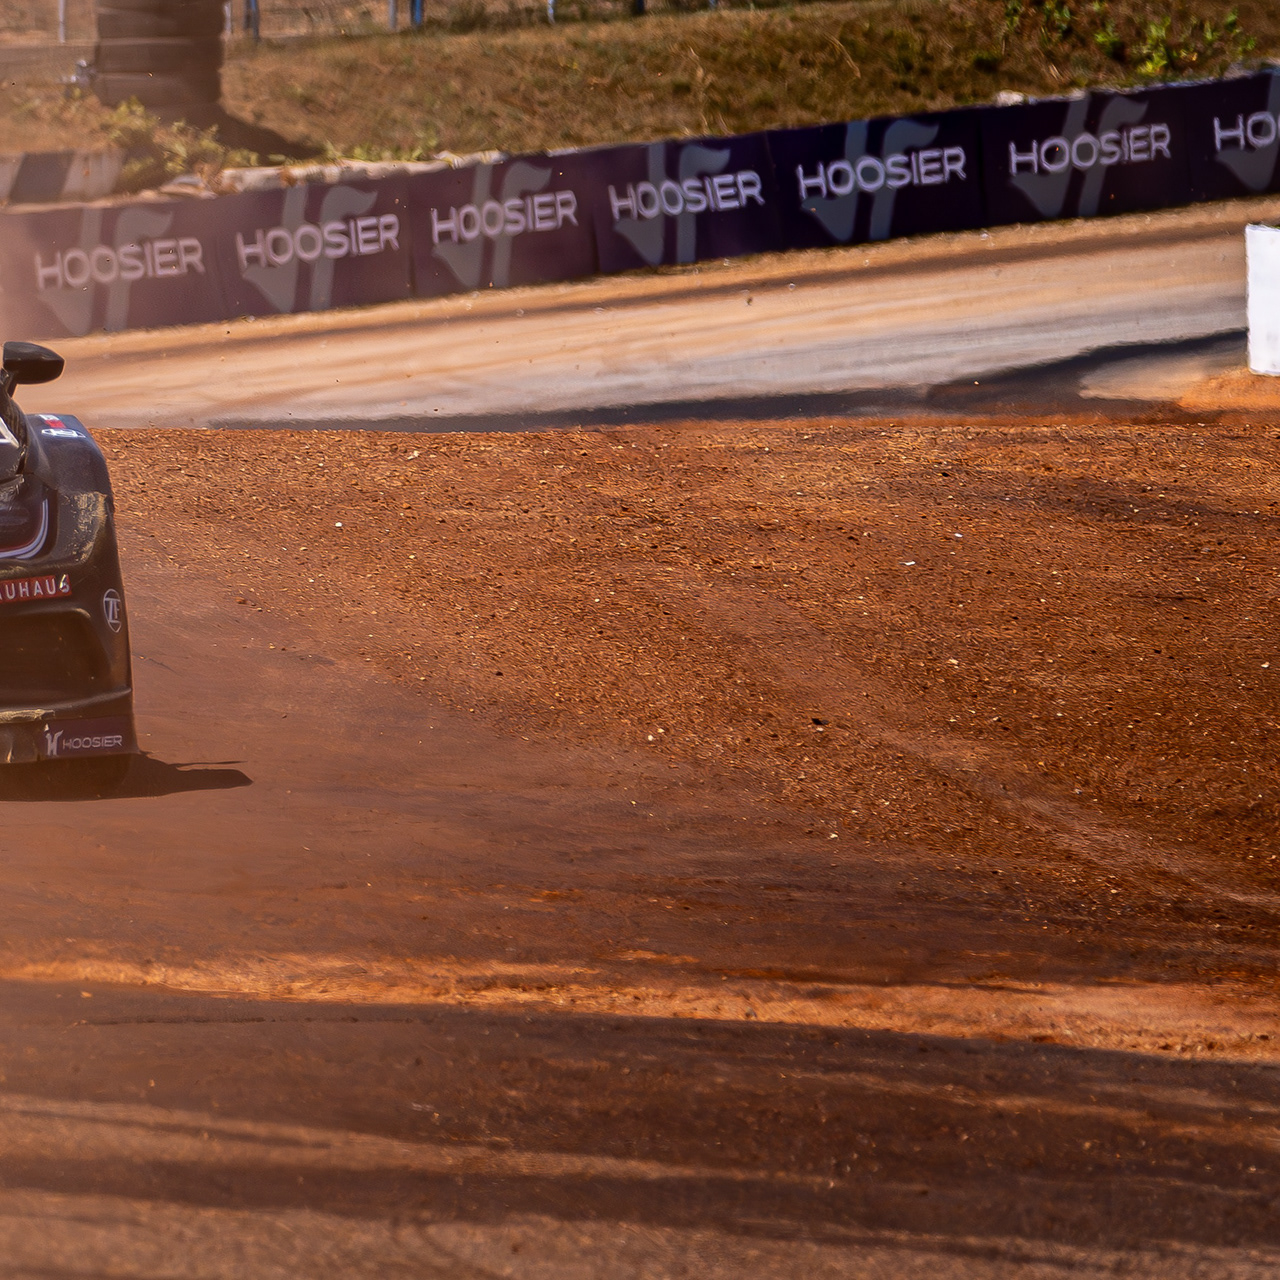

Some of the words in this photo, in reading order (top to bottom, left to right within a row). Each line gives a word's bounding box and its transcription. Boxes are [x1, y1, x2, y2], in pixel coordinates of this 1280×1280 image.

[796, 146, 968, 200] HOOSIER
[1009, 123, 1171, 175] HOOSIER
[430, 190, 579, 247] HOOSIER
[608, 170, 765, 220] HOOSIER
[36, 237, 206, 290] HOOSIER
[236, 213, 400, 269] HOOSIER
[62, 734, 123, 750] HOOSIER
